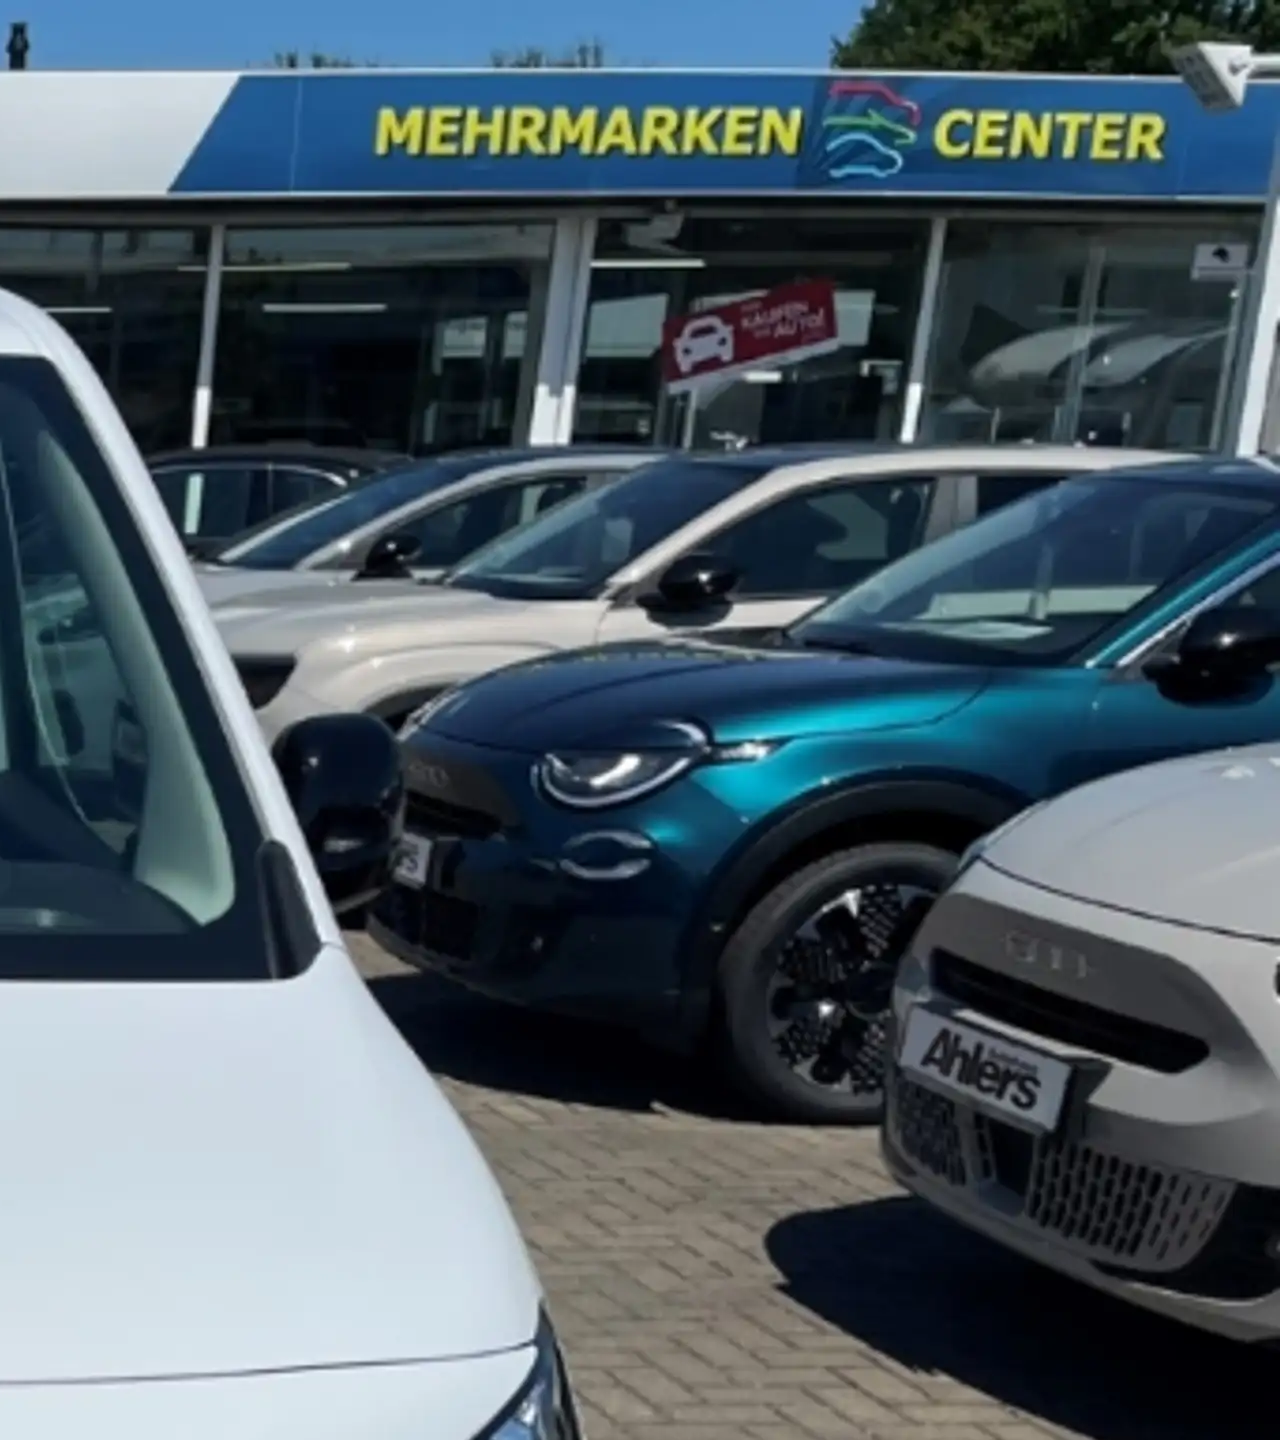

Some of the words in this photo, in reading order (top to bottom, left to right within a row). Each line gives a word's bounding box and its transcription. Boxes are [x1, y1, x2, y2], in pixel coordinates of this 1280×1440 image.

[373, 104, 804, 157] MEHRMARKEN
[932, 107, 1168, 162] CENTER
[919, 1027, 1042, 1112] Ahlers
